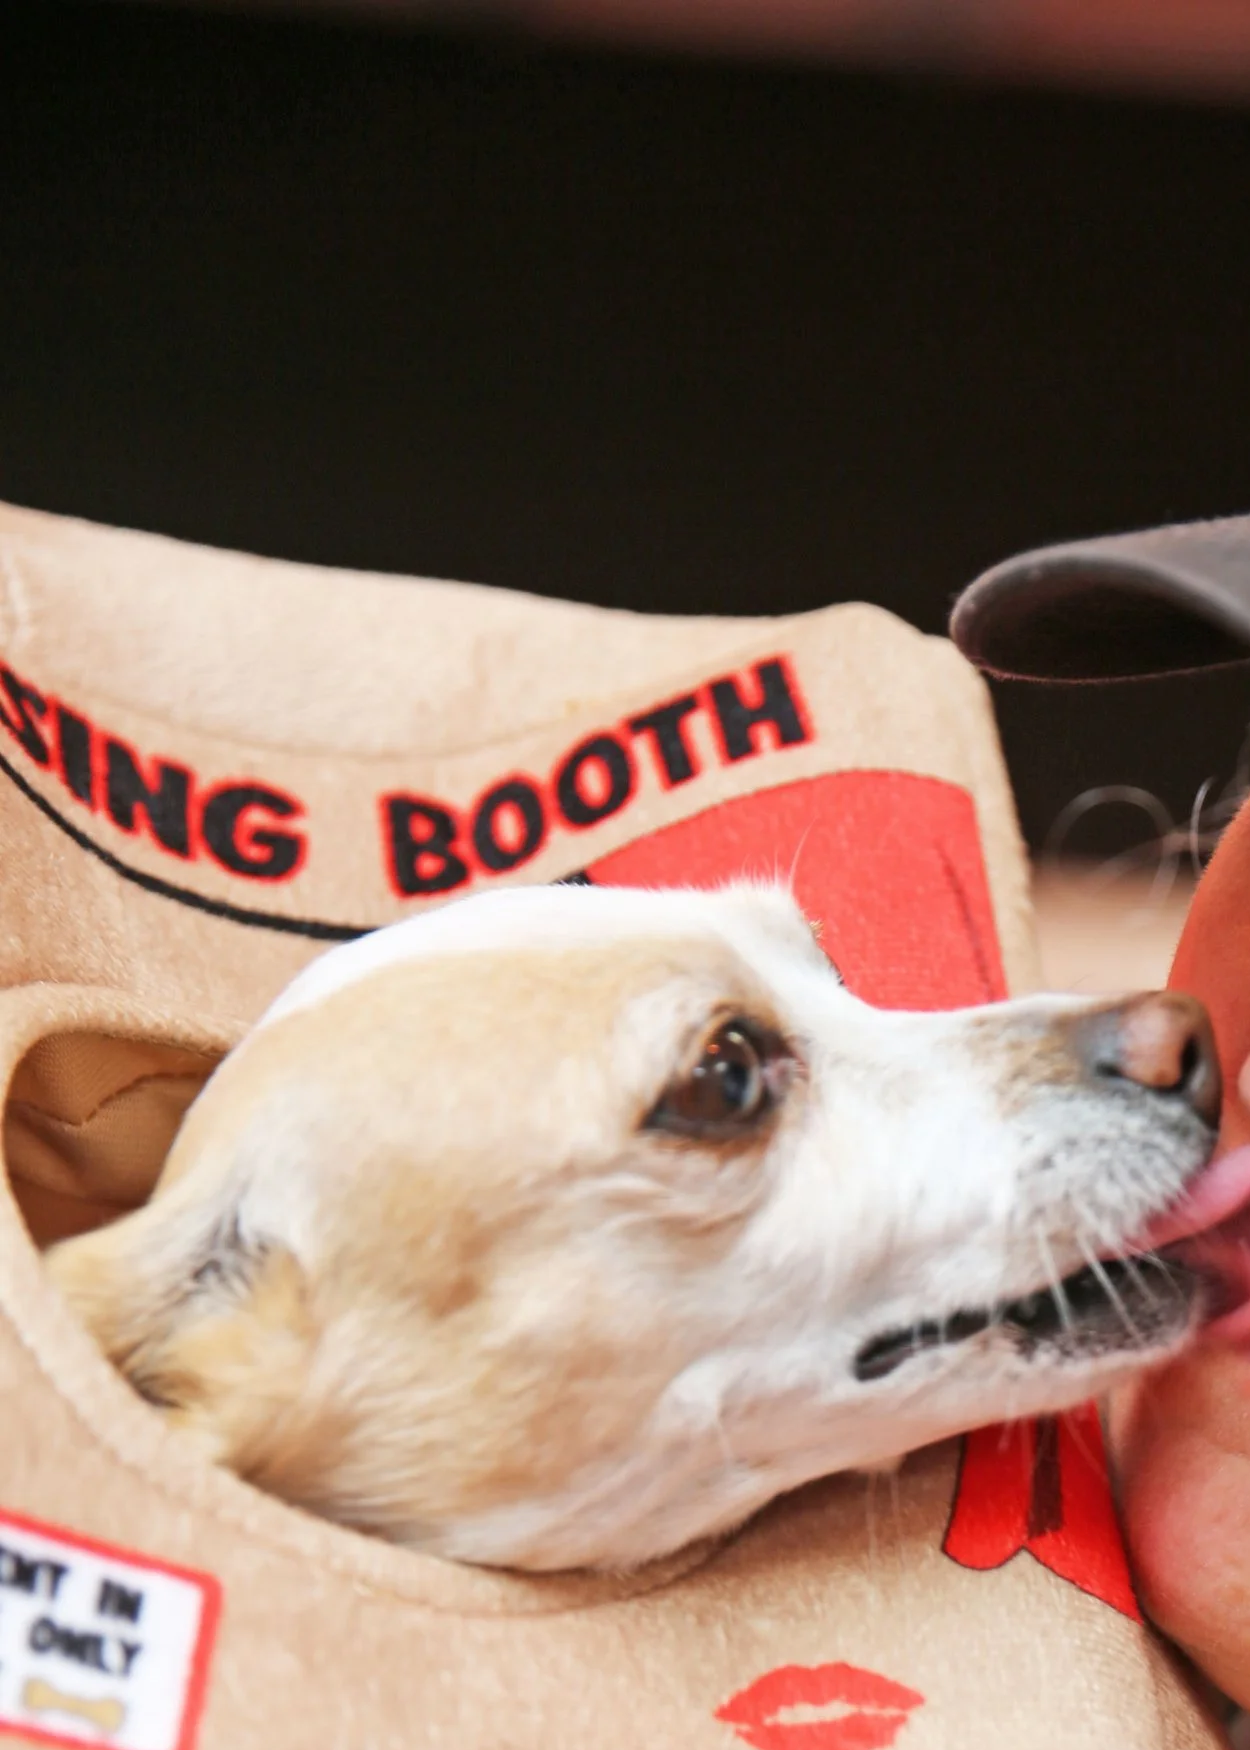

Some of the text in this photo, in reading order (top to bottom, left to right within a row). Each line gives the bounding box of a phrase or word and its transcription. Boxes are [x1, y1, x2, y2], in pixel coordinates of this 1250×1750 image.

[377, 654, 814, 897] BOOTH
[98, 1577, 143, 1625] IN
[28, 1615, 143, 1677] ONLY
